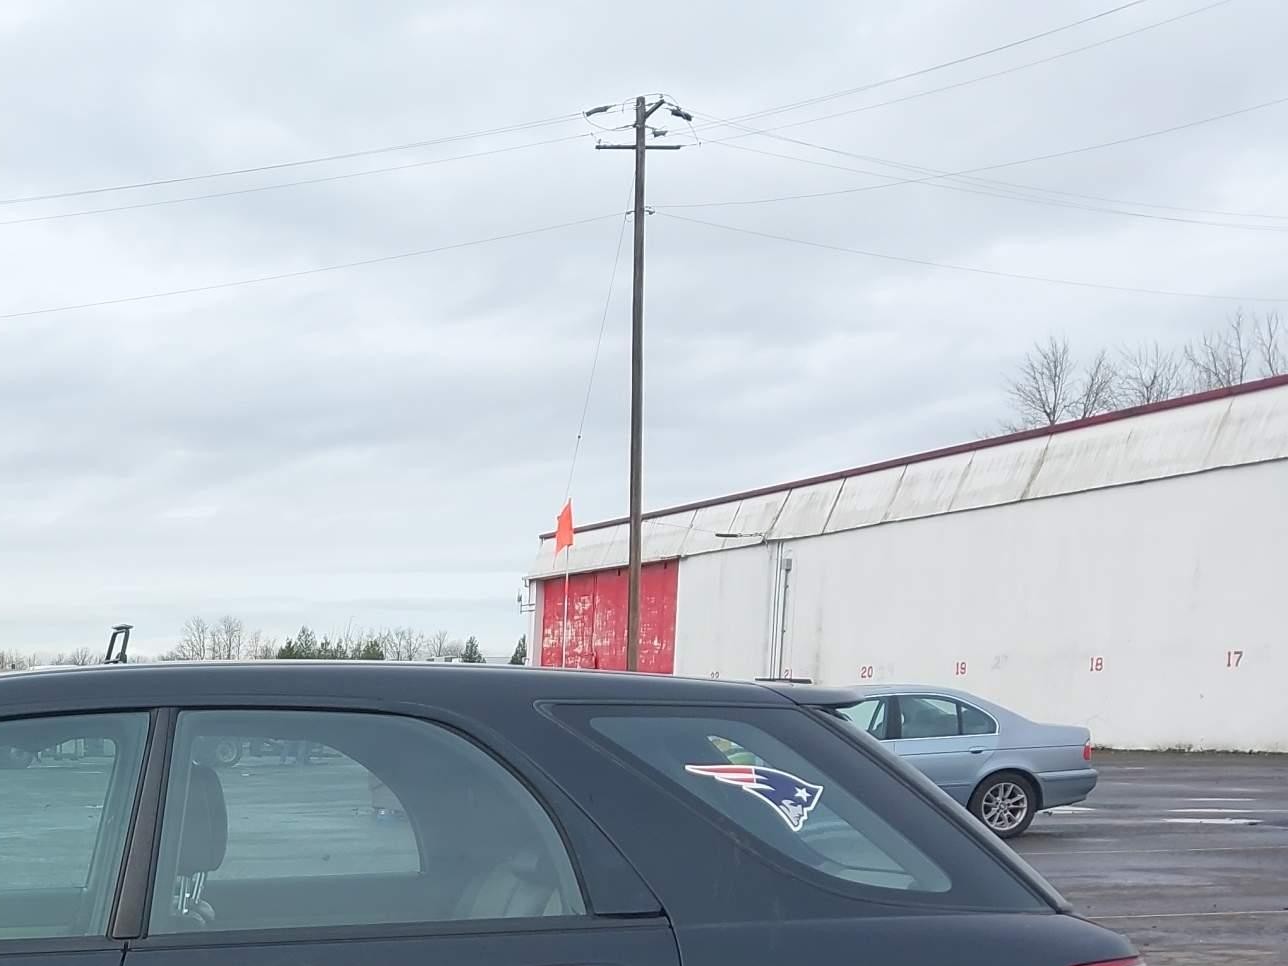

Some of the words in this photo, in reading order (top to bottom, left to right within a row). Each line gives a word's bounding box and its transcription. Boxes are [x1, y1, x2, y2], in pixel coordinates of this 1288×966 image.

[1089, 656, 1104, 672] 18
[1226, 650, 1243, 668] 17
[860, 665, 874, 679] 20
[955, 661, 967, 676] 19
